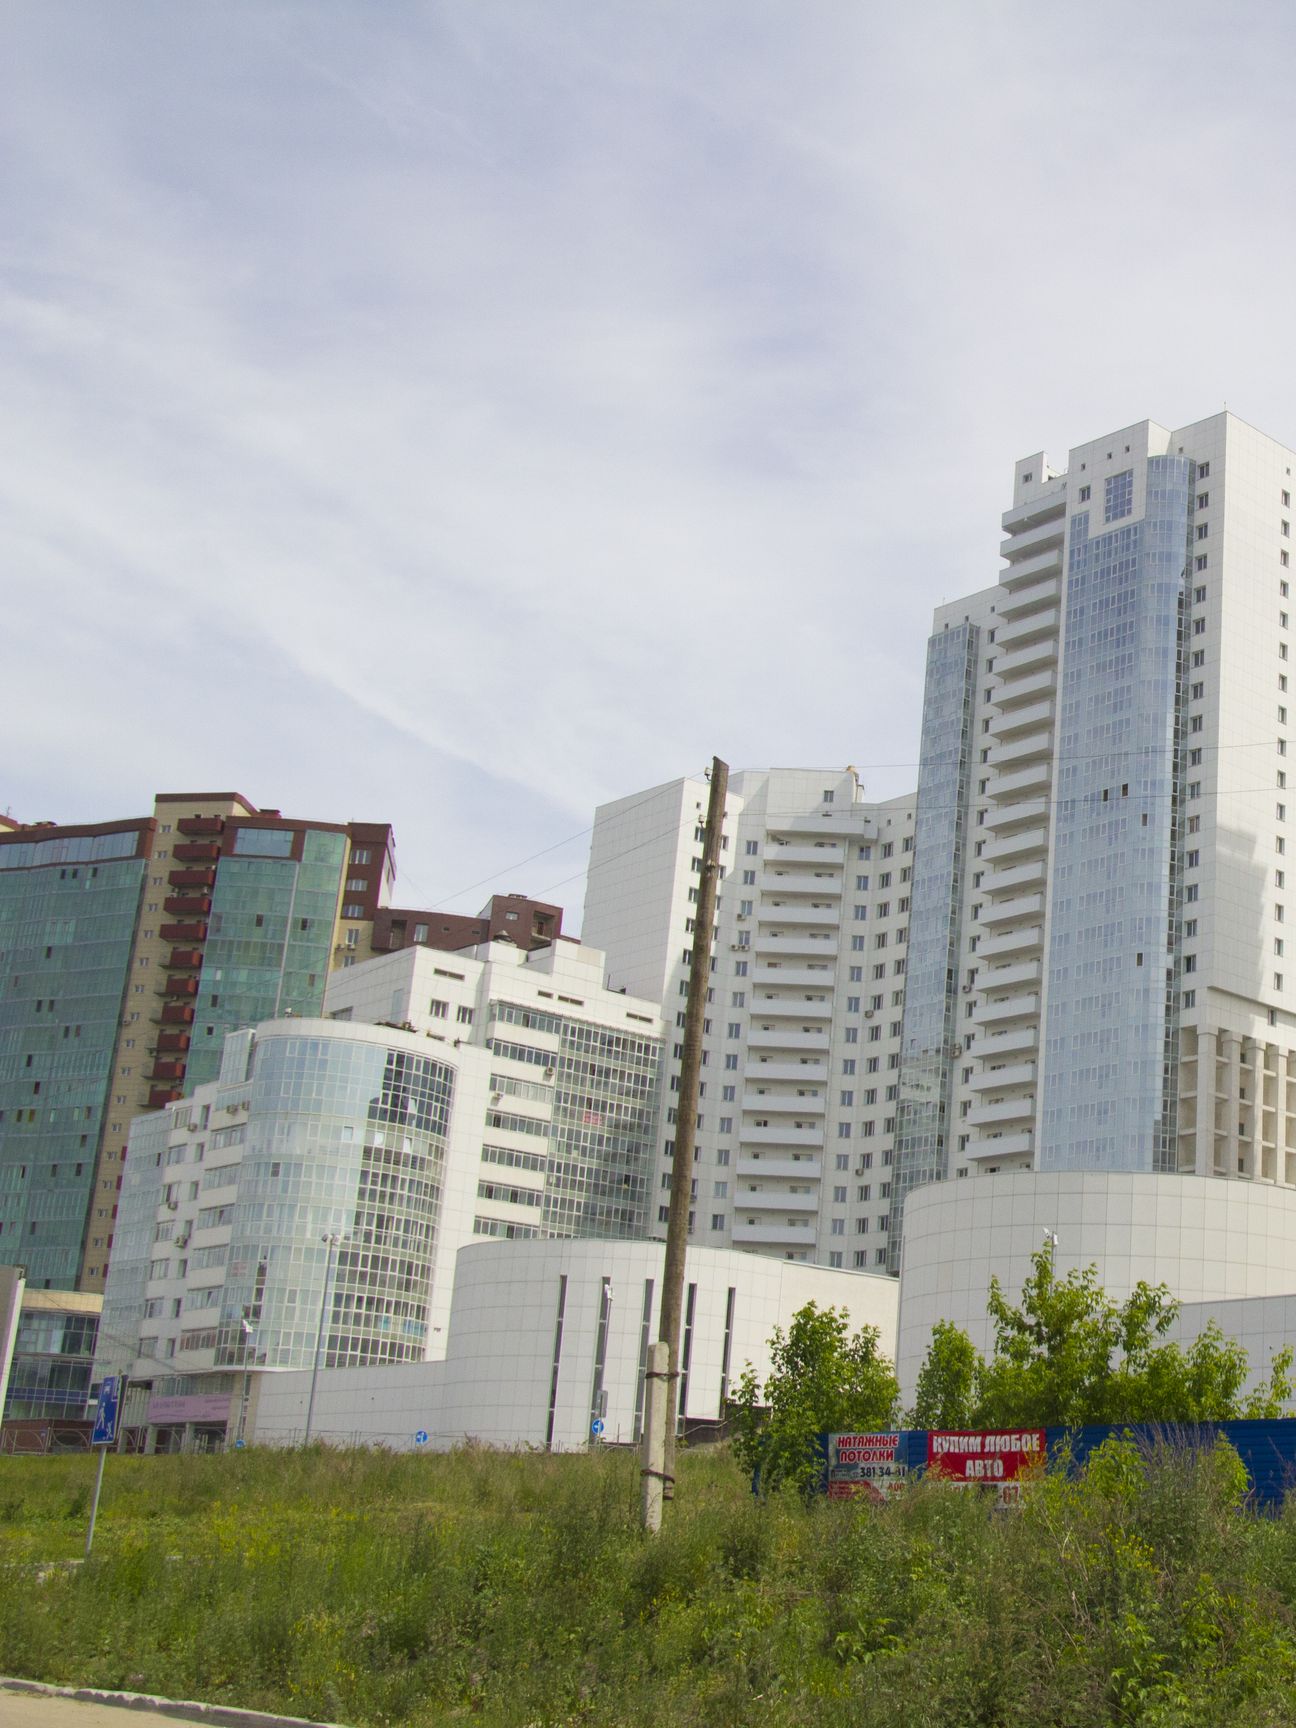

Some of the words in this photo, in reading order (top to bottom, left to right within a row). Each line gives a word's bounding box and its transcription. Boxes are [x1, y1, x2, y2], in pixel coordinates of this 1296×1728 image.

[932, 1435, 982, 1453] КУПИМ
[984, 1433, 1040, 1453] ЛЮБОЕ
[840, 1450, 894, 1463] ПОТОЛКИ
[965, 1459, 1004, 1477] АВТО
